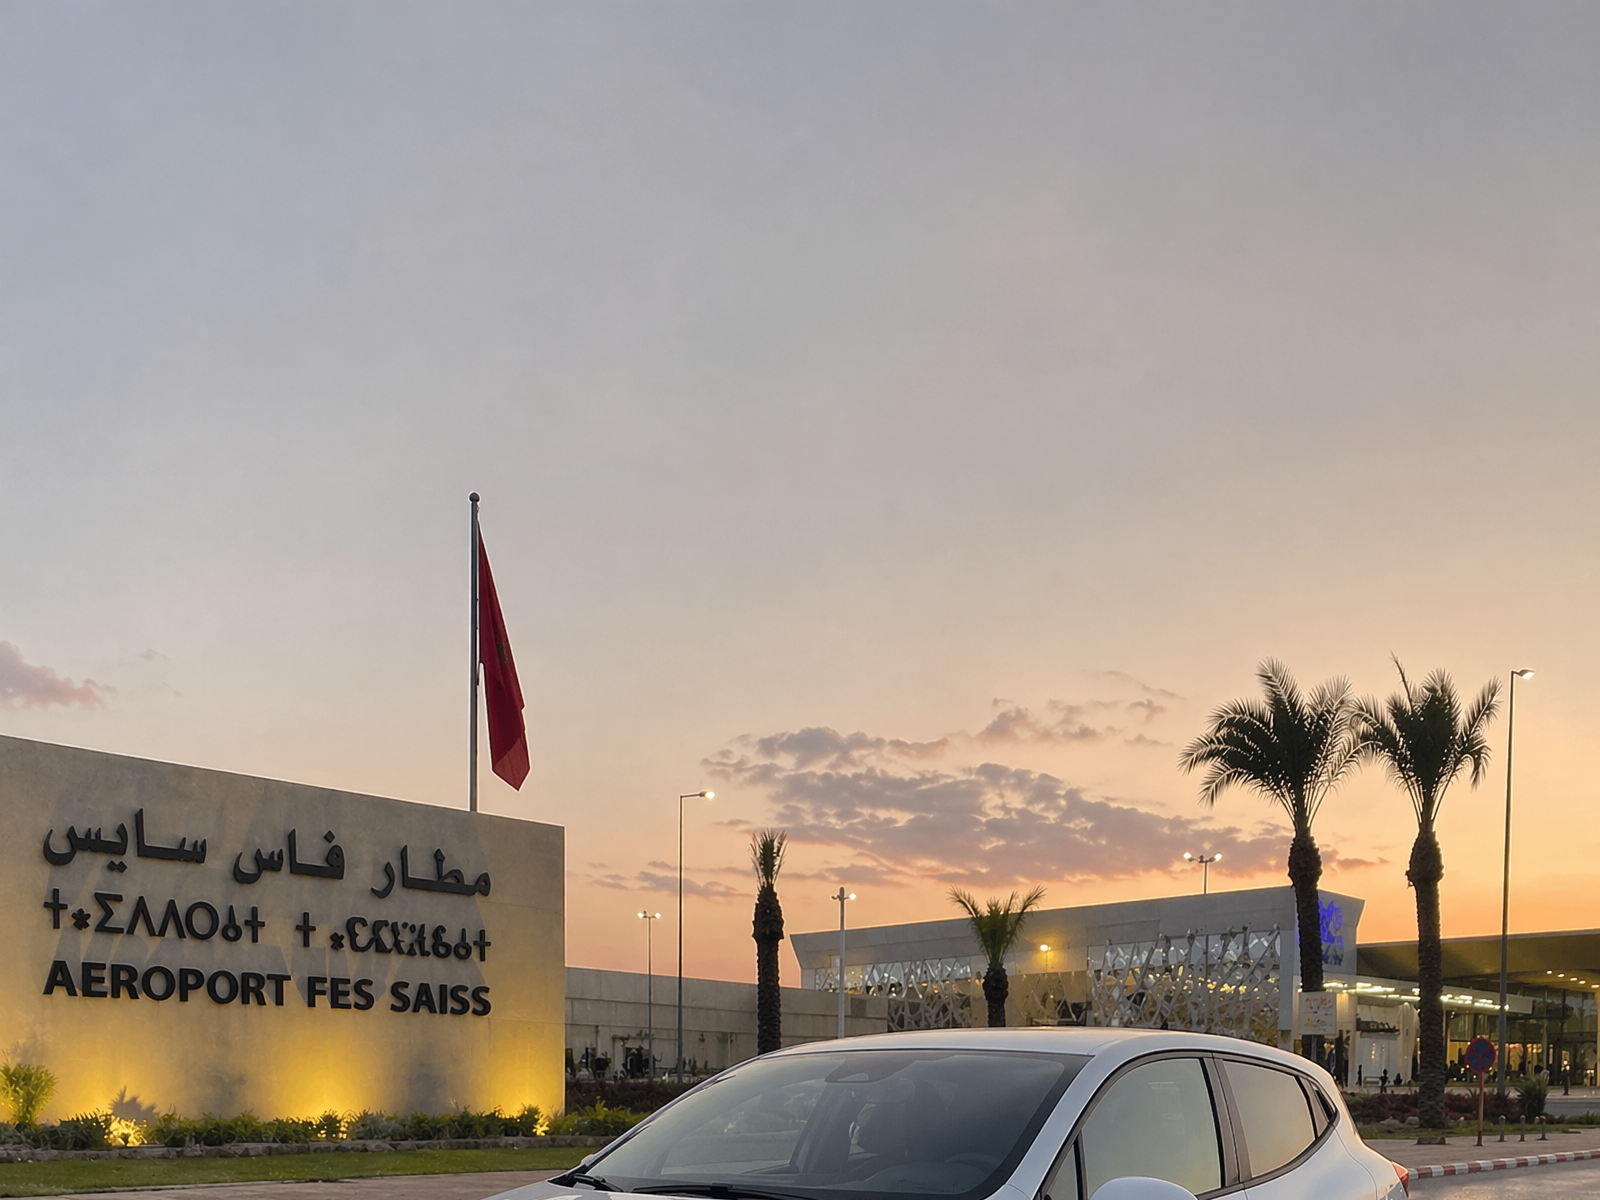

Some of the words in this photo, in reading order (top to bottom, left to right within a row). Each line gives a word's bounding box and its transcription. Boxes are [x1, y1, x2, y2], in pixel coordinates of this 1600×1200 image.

[42, 807, 207, 874] سايس
[232, 828, 345, 885] فاس
[370, 844, 491, 900] مطار
[42, 959, 292, 1007] AEROPORT
[307, 975, 375, 1011] FES
[389, 980, 492, 1017] SAISS
